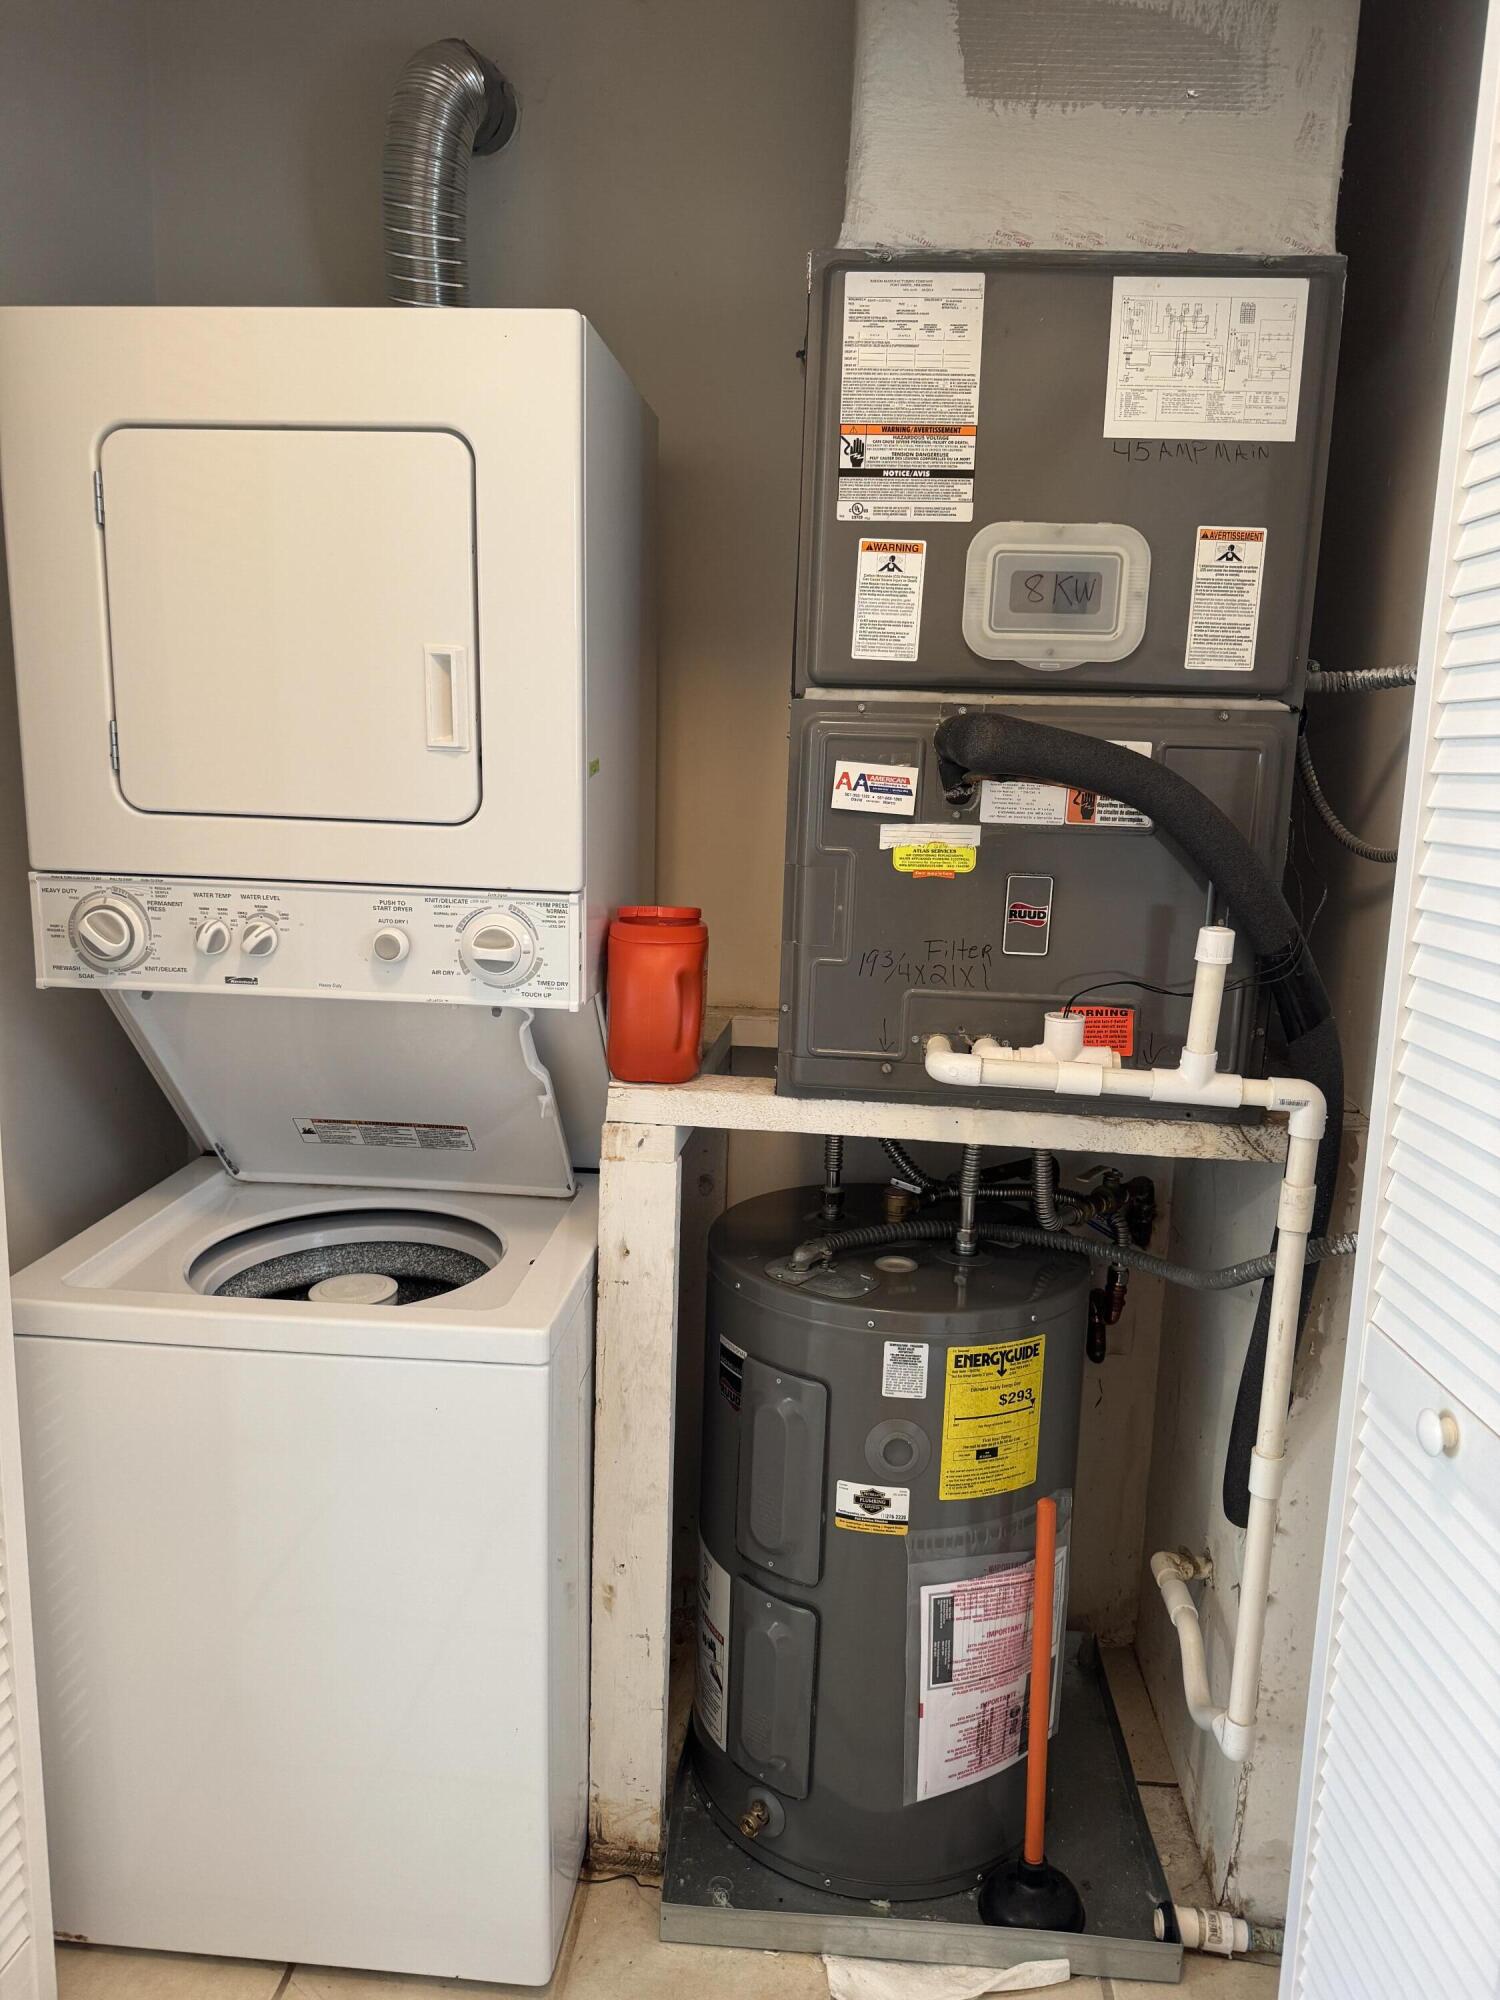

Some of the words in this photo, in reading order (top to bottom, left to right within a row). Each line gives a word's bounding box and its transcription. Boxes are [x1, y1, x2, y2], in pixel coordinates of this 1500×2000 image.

[881, 426, 962, 434] WARNING/AVERTISSEMENT
[1112, 441, 1150, 462] 45
[1159, 441, 1208, 464] AMP
[1209, 531, 1264, 541] AVERTISSEMENT
[873, 543, 919, 553] WARNING
[1024, 573, 1045, 603] 8
[869, 775, 907, 784] AMERICAN
[1008, 909, 1047, 920] RUUD
[954, 1342, 1041, 1370] ENERGYGUIDE
[998, 1387, 1033, 1406] $293
[986, 1623, 1023, 1639] IMPORTANT
